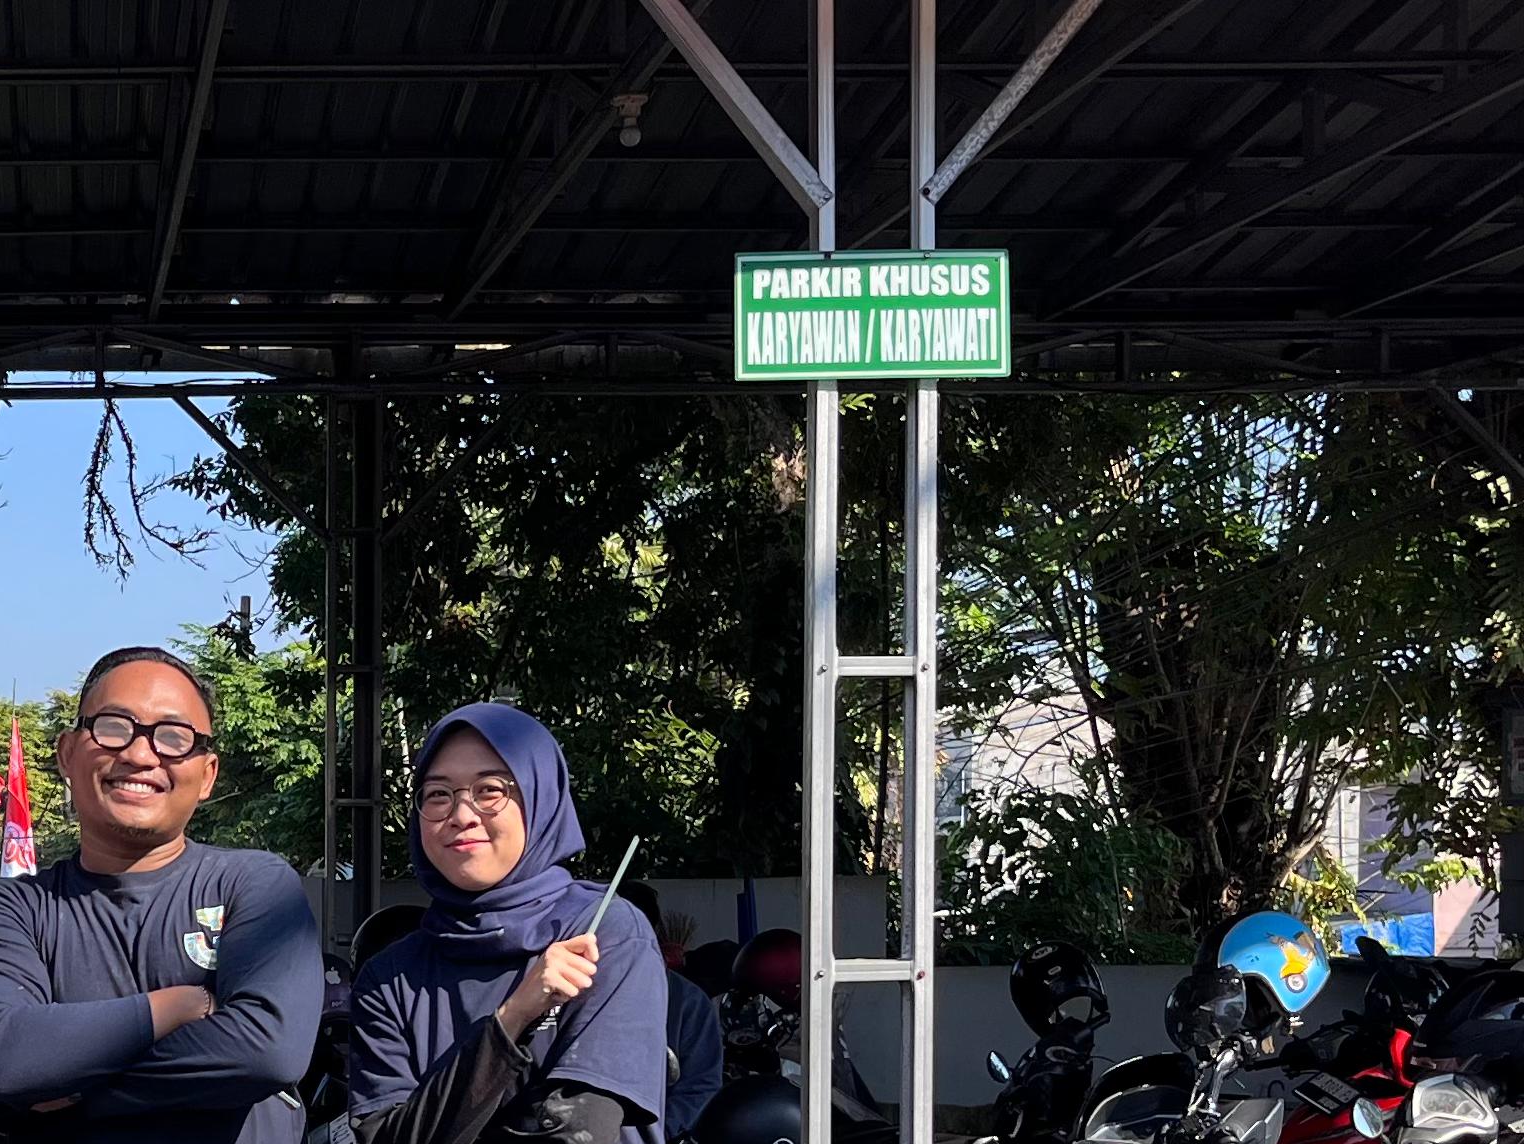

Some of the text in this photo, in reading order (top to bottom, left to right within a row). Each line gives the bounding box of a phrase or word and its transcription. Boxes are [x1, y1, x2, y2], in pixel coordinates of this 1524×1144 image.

[752, 264, 990, 299] PARKIR KHUSUS
[747, 308, 997, 365] KARYAWAN / KARYAWATI
